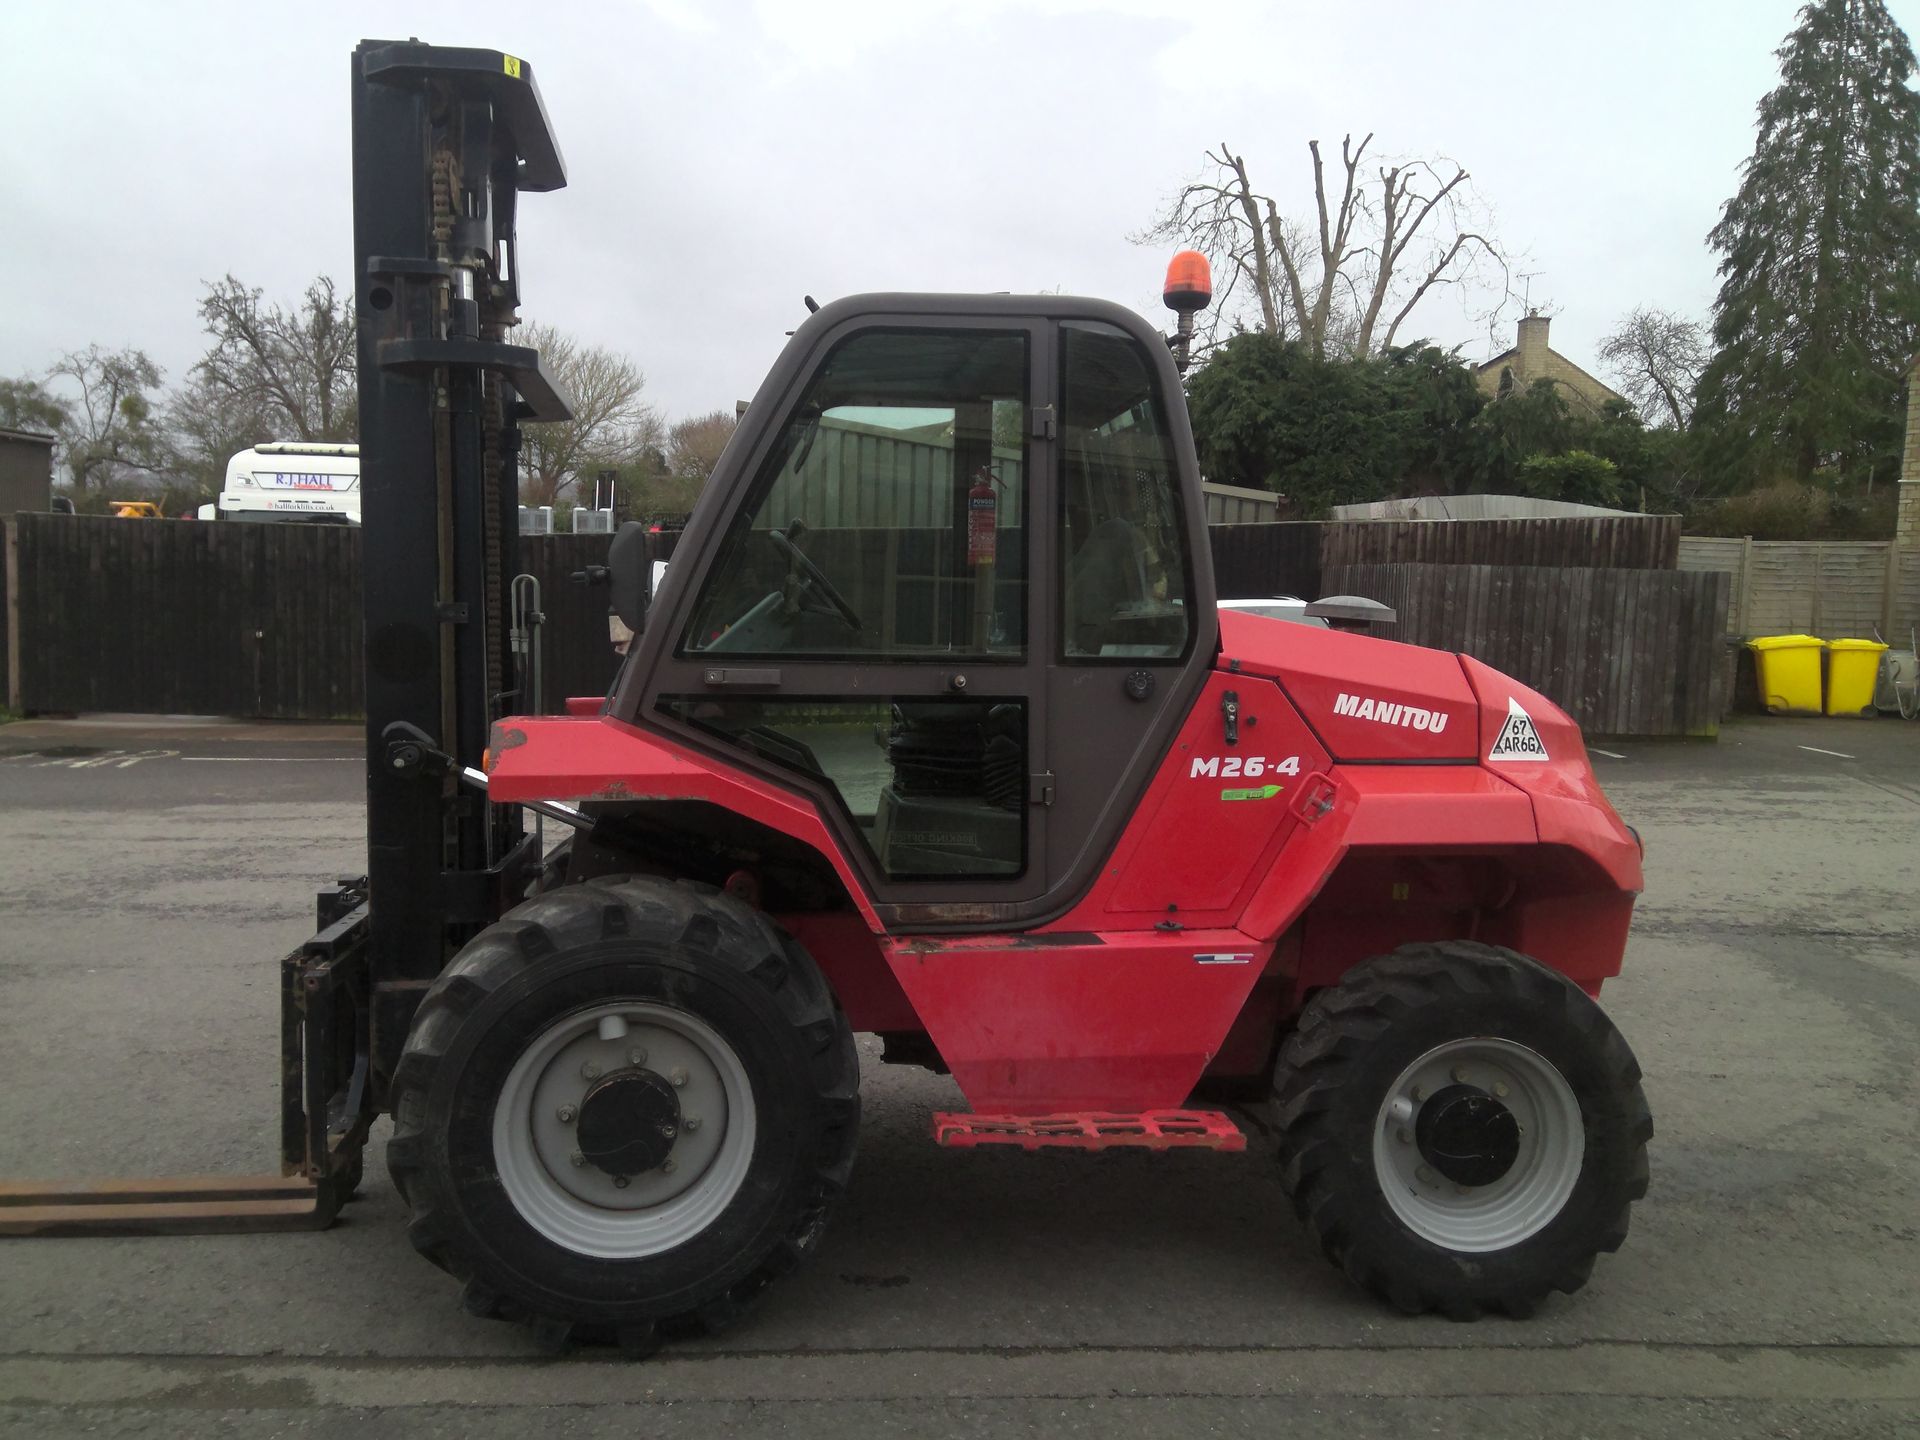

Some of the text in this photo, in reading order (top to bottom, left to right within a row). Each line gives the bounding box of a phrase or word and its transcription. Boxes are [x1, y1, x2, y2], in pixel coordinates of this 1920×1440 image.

[1333, 693, 1449, 734] MANITOU
[1512, 720, 1527, 736] 67
[1504, 737, 1536, 753] AR6G
[1190, 756, 1300, 778] M26-4
